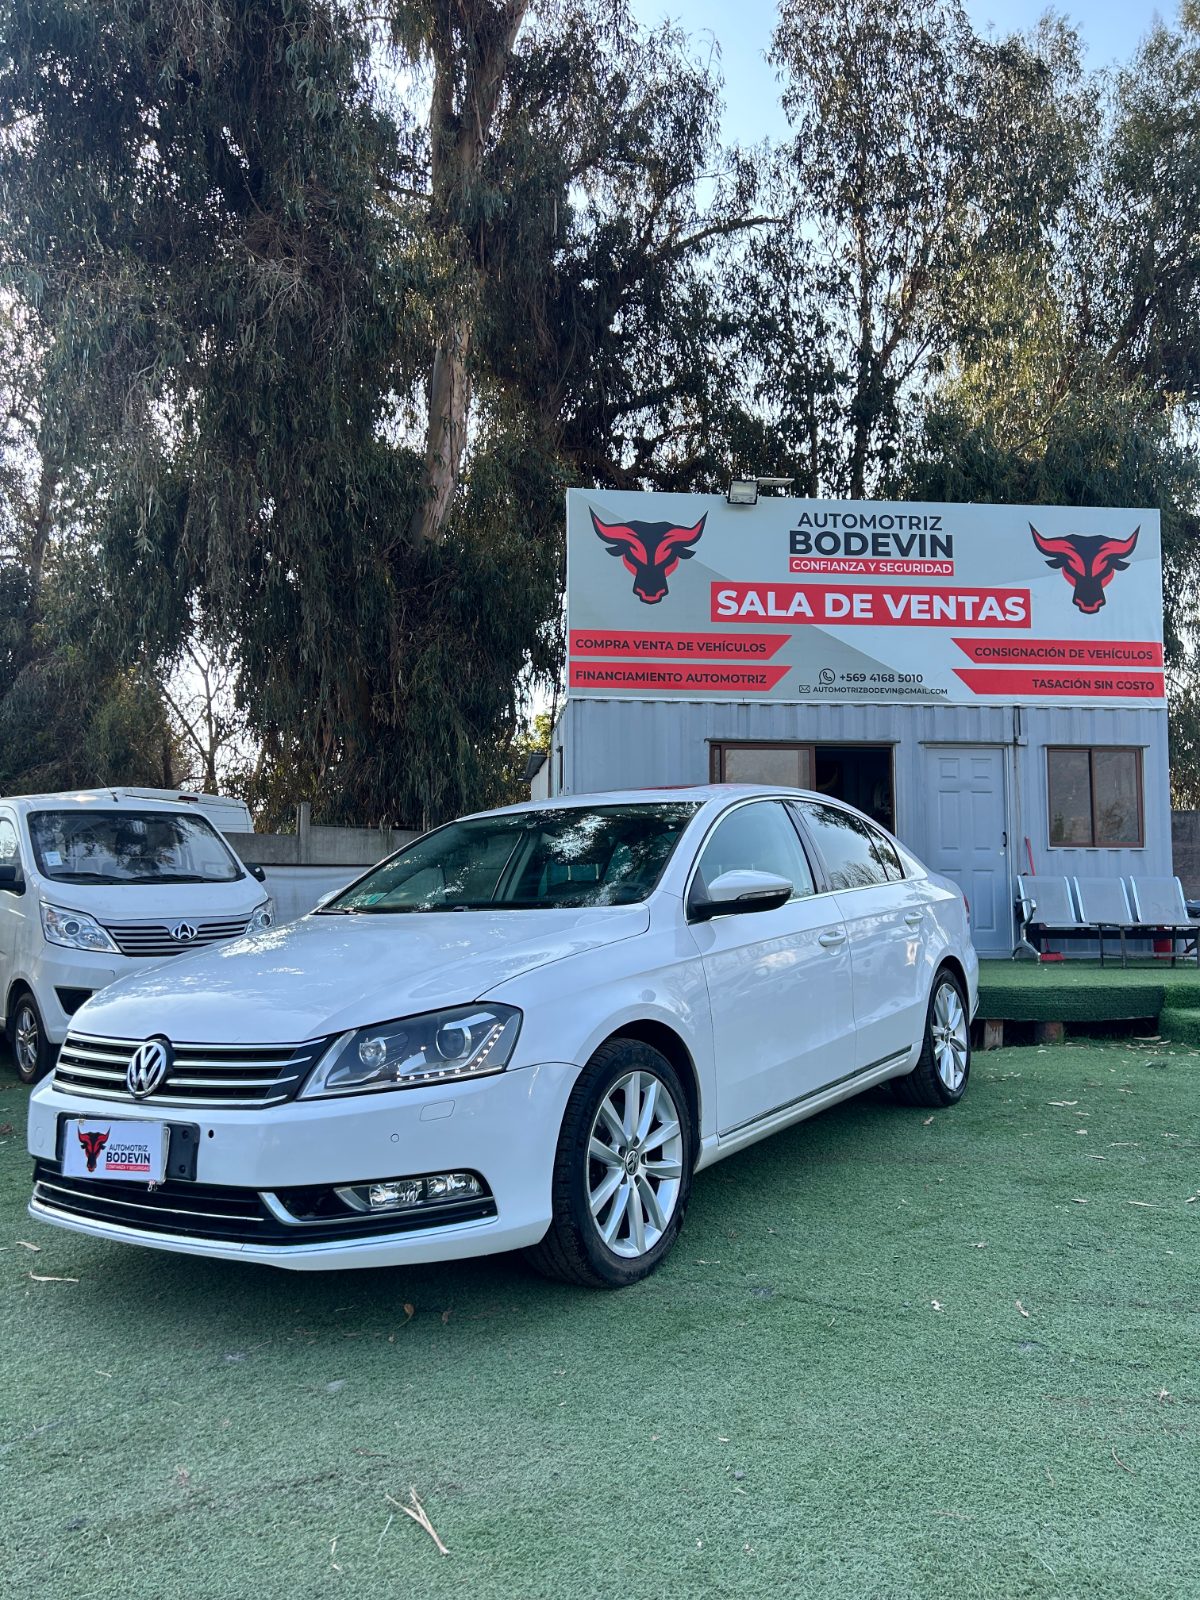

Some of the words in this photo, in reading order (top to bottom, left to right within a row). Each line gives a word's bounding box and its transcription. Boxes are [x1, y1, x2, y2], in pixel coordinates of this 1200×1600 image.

[798, 512, 942, 531] AUTOMOTRIZ
[789, 530, 953, 558] BODEVIN
[792, 560, 865, 572] CONFIANZA
[869, 562, 877, 572] Y
[879, 562, 952, 574] SEGURIDAD
[716, 590, 814, 617] SALA
[824, 592, 874, 619] DE
[883, 594, 1027, 621] VENTAS
[575, 638, 630, 649] COMPRA
[633, 640, 674, 651] VENTA
[677, 641, 694, 651] DE
[697, 640, 767, 653] VEHÍCULOS
[974, 646, 1066, 659] CONSIGNACIÓN
[1069, 649, 1085, 659] DE
[1087, 648, 1153, 660] VEHÍCULOS
[575, 670, 683, 683] FINANCIAMIENTO
[685, 672, 767, 684] AUTOMOTRIZ
[839, 673, 867, 682] +569
[869, 673, 895, 683] 4168
[897, 674, 924, 683] 5010
[812, 686, 949, 695] AUTOMOTRIZBODEVIN@GMAIL.COM
[1032, 678, 1092, 689] TASACIÓN
[1094, 680, 1114, 690] SIN
[1115, 680, 1155, 691] COSTO
[109, 1143, 148, 1152] AUTOMOTRIZ
[106, 1152, 151, 1164] BODEVIN
